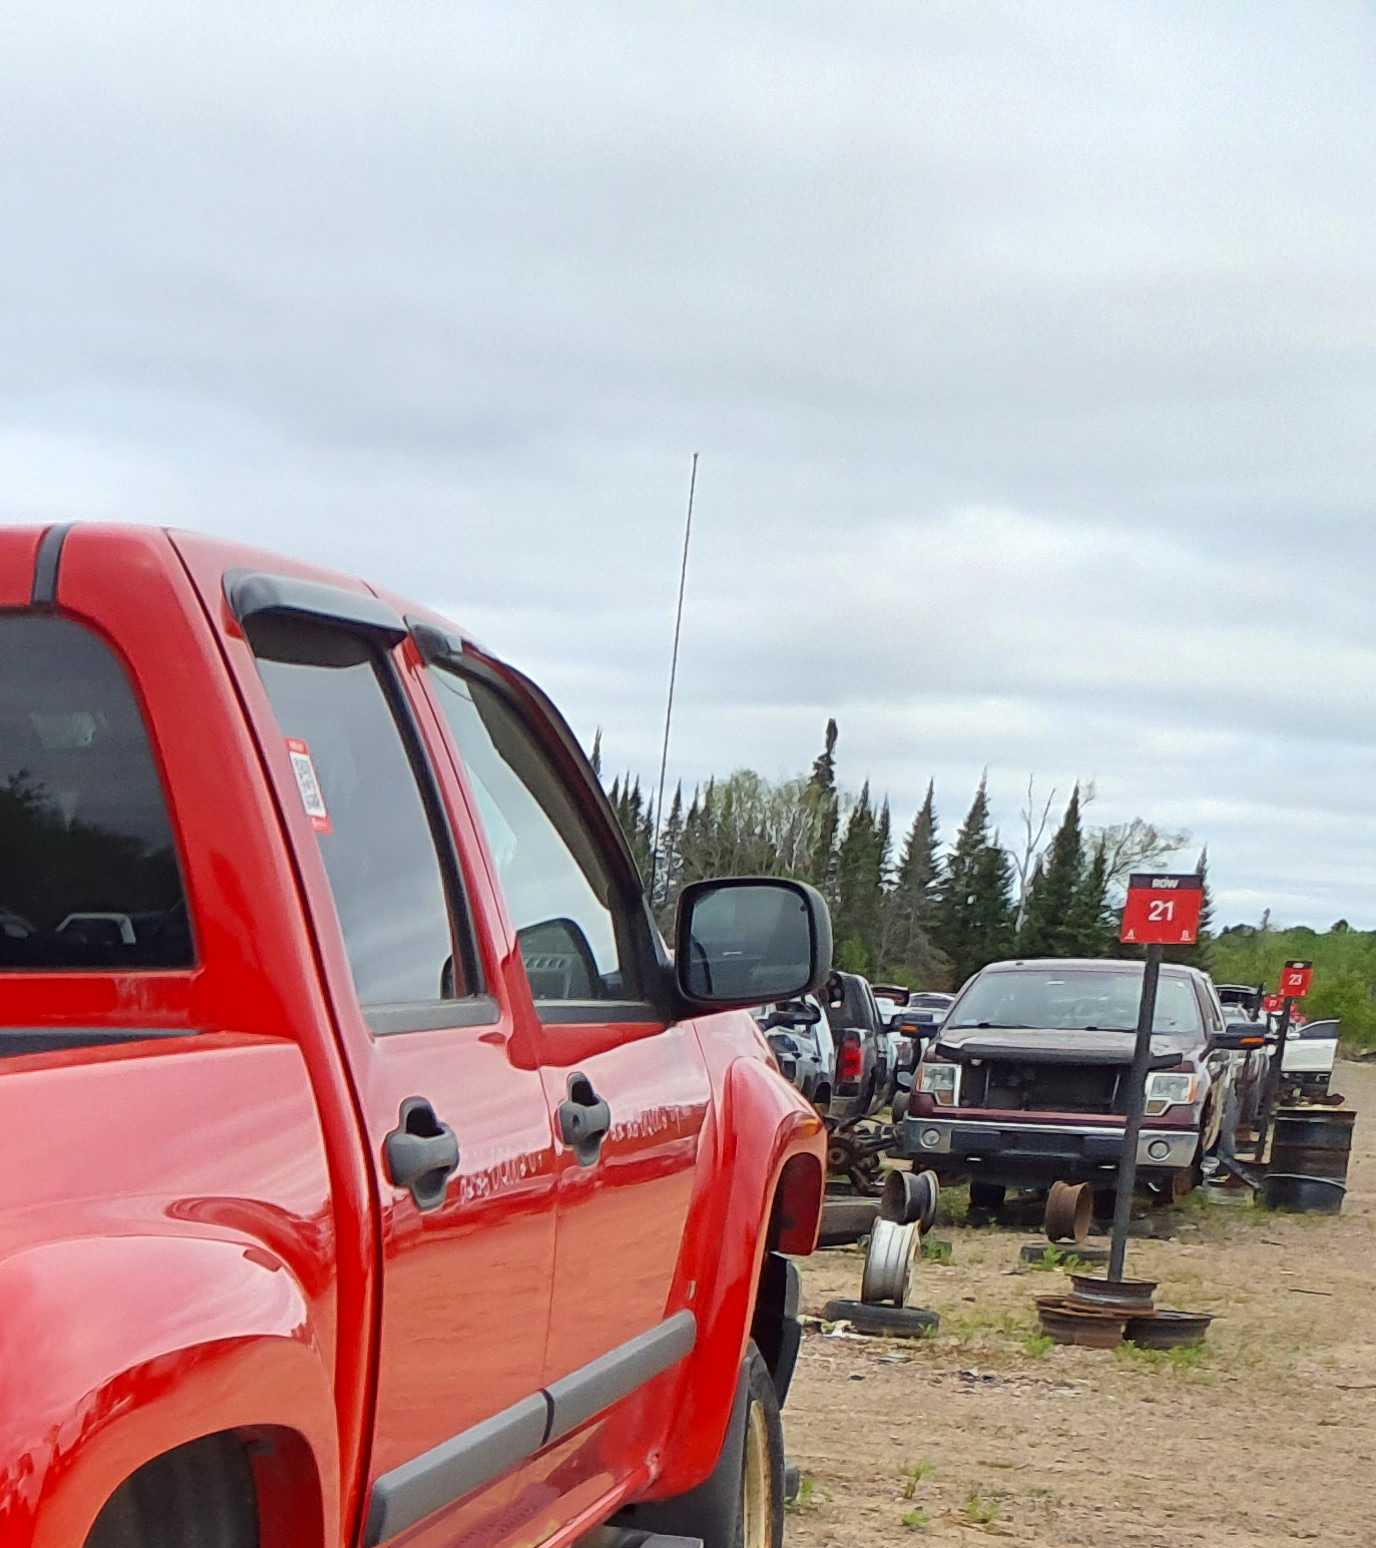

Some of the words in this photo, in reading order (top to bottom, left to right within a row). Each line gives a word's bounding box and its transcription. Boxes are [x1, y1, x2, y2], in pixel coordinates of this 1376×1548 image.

[1151, 879, 1179, 888] ROW
[1148, 900, 1174, 921] 21
[1288, 974, 1303, 986] 23
